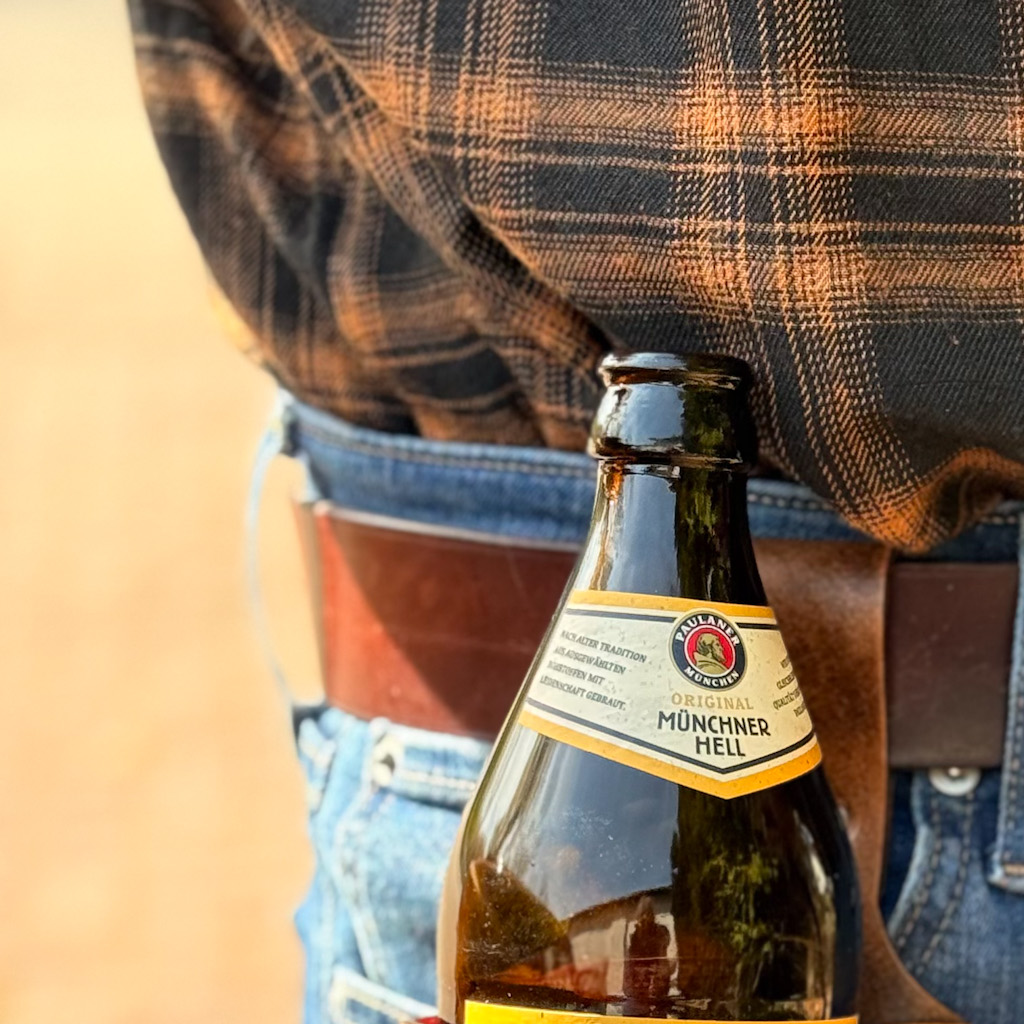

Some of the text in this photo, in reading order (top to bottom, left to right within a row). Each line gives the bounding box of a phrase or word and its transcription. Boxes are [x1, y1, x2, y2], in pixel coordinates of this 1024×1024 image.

[675, 615, 741, 647] PAULANER
[565, 648, 626, 675] AUSGEWÄHLTEN
[576, 636, 599, 648] ALTER
[600, 642, 647, 663] TRADITION
[587, 673, 606, 686] MIT
[586, 691, 626, 711] GEBRAUT.
[671, 693, 754, 710] ORIGINAL
[657, 709, 771, 736] MÜNCHNER
[695, 736, 746, 757] HELL
